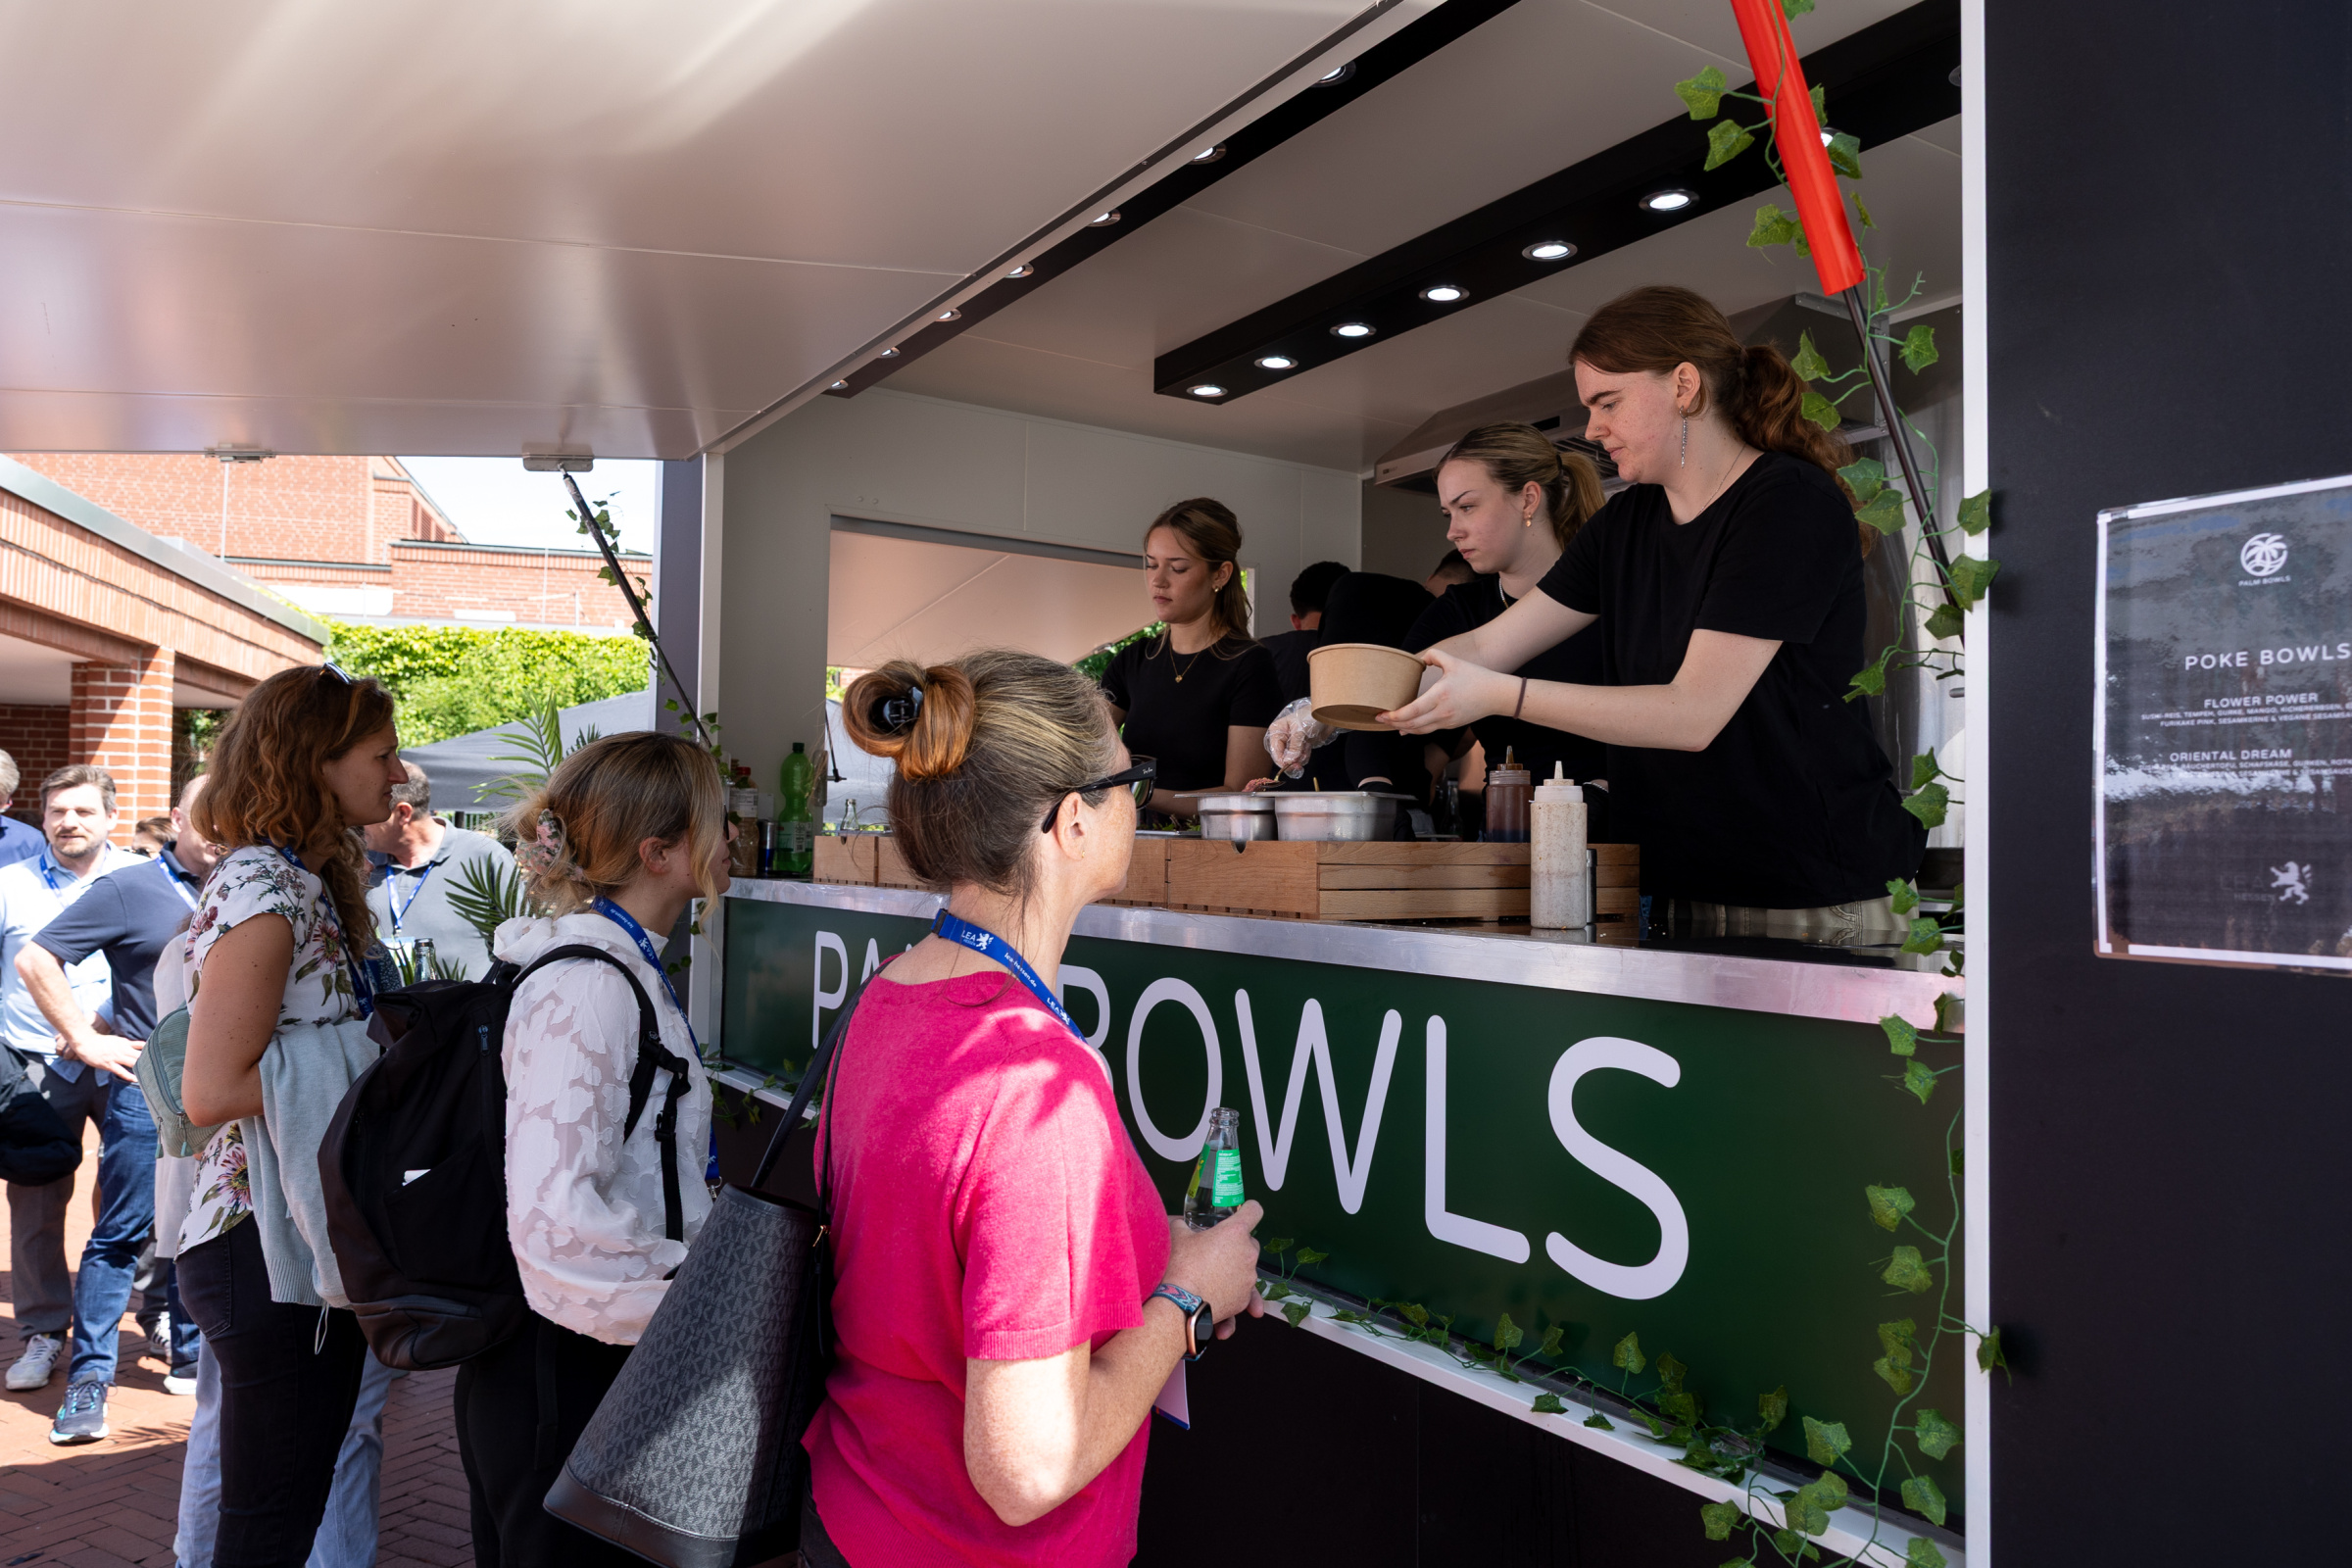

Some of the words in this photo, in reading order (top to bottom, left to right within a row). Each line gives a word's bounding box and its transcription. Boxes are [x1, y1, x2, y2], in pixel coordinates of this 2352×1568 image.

[2262, 575, 2291, 585] BOWLS
[2184, 651, 2248, 670] POKE
[2260, 643, 2352, 665] BOWLS
[2203, 696, 2261, 709] FLOWER
[2266, 692, 2319, 705] POWER
[2169, 751, 2236, 761] ORIENTAL
[2240, 748, 2292, 760] DREAM
[960, 929, 976, 942] LEA
